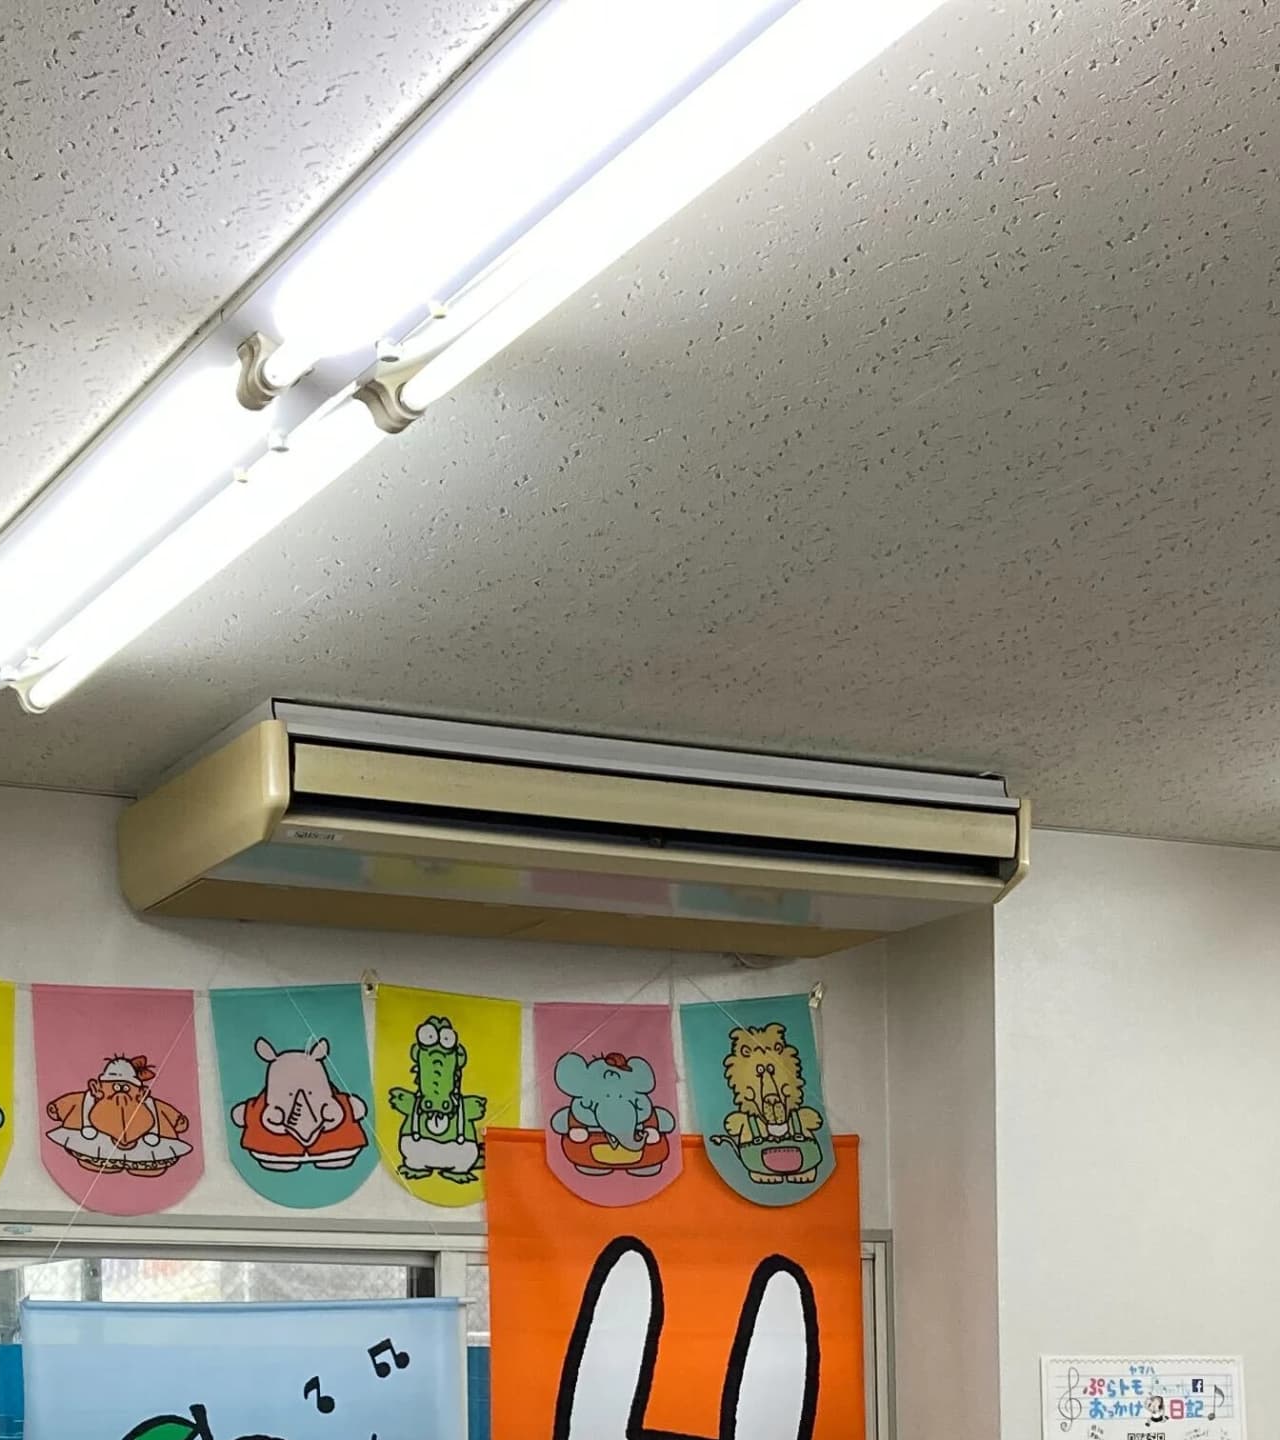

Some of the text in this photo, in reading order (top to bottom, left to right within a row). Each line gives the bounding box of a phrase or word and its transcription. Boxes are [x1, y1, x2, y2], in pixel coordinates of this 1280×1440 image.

[1089, 1398, 1204, 1419] おっかけ 日記
